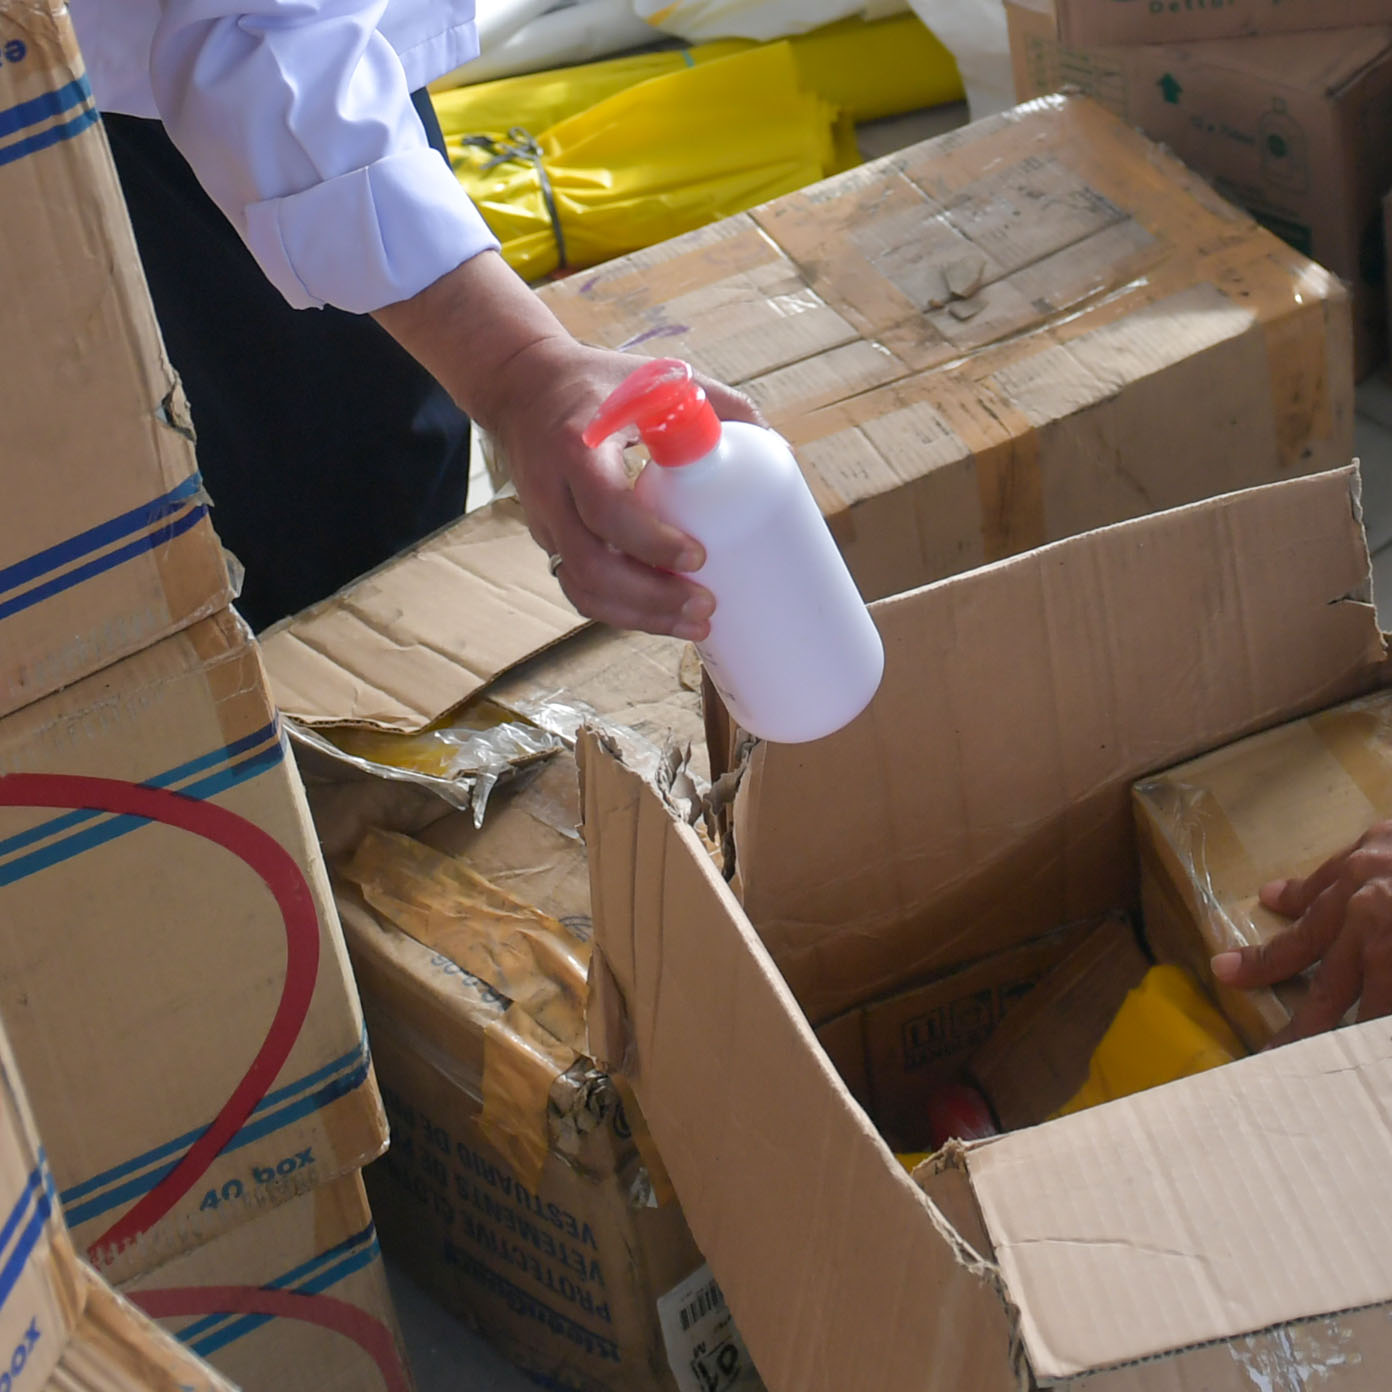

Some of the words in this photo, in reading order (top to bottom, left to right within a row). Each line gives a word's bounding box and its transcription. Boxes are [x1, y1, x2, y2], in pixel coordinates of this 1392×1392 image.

[200, 1177, 245, 1212] 40
[251, 1144, 316, 1189] box
[456, 1142, 599, 1251] VESTUARIO
[461, 1212, 613, 1326] PROTECTIVE
